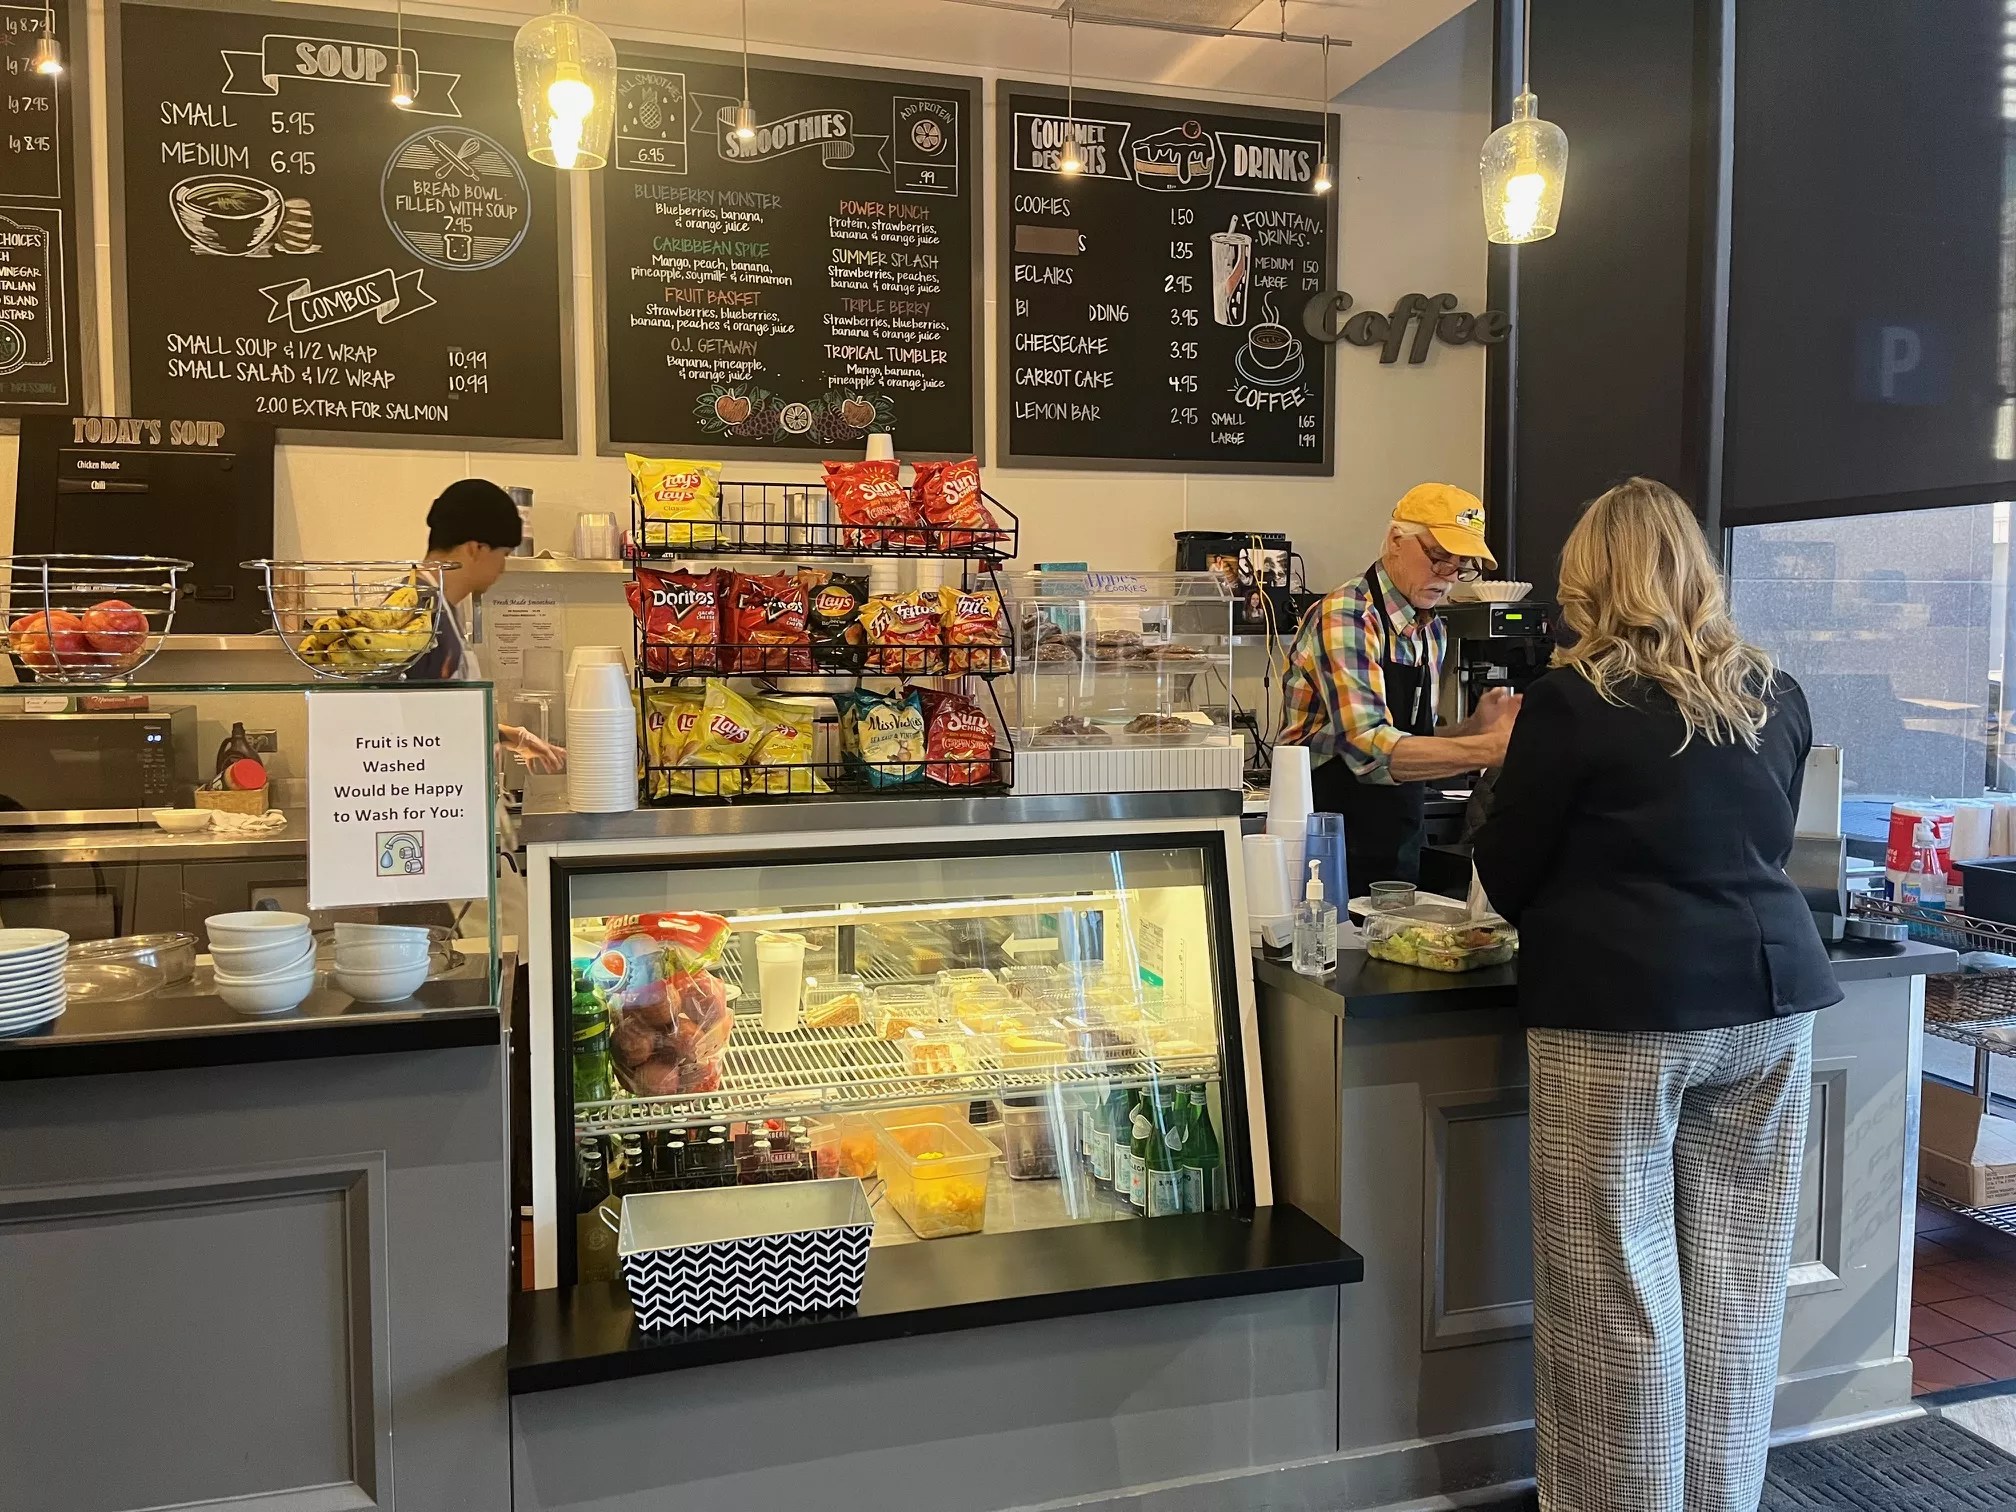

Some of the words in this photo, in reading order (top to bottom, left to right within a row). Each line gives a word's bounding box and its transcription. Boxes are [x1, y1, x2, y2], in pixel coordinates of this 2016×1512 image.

[296, 42, 387, 81] SOUP
[22, 97, 49, 111] 7.95
[900, 104, 918, 120] ADD
[918, 102, 954, 124] PROTEIN
[161, 101, 237, 127] SMALL
[271, 112, 315, 135] 5.95
[725, 113, 847, 158] SMOOTHIES
[162, 142, 249, 169] MEDIUM
[271, 151, 316, 174] 6.95
[638, 148, 665, 162] 6.95
[1234, 144, 1311, 182] DRINKS
[919, 170, 935, 184] .99
[414, 180, 459, 198] BREAD
[465, 184, 503, 200] BOWL
[635, 184, 714, 205] BLUEBERRY
[719, 191, 782, 210] MONSTER
[396, 195, 445, 213] FILLED
[450, 201, 483, 217] WITH
[486, 203, 517, 219] SOUP
[656, 203, 718, 220] Blueberries,
[721, 208, 763, 223] banana,
[840, 200, 886, 217] POWER
[889, 203, 930, 220] PUNCH
[1015, 195, 1070, 217] COOKIES
[1171, 208, 1194, 225] 1.50
[444, 216, 472, 232] 7.95
[686, 219, 722, 233] orange
[723, 220, 750, 234] juice
[829, 216, 870, 230] Protein,
[872, 219, 937, 234] strawberries,
[653, 236, 731, 255] CARIBBEAN
[735, 242, 770, 258] SPICE
[830, 228, 868, 240] banana
[881, 232, 916, 246] orange
[917, 234, 940, 247] juice
[652, 255, 691, 270] Mango,
[694, 258, 728, 271] peach,
[731, 259, 773, 273] banana,
[832, 248, 888, 266] SUMMER
[891, 252, 939, 269] SPLASH
[1255, 257, 1293, 271] MEDIUM
[631, 267, 684, 283] pineapple,
[686, 269, 727, 283] soymilk
[740, 273, 793, 286] cinnamon
[828, 265, 895, 281] Strawberries,
[897, 272, 940, 284] peaches,
[1015, 265, 1073, 285] ECLAIRS
[1164, 274, 1193, 293] 2.95
[1254, 275, 1288, 289] LARGE
[1302, 278, 1318, 291] 1.79
[830, 277, 869, 290] banana
[882, 282, 915, 296] orange
[917, 283, 941, 296] juice
[3, 296, 39, 306] ISLAND
[301, 281, 382, 323] COMBOS
[665, 287, 704, 304] FRUIT
[707, 290, 761, 306] BASKET
[646, 304, 718, 319] Strawberries,
[721, 308, 780, 322] blueberries,
[841, 298, 886, 314] TRIPLE
[890, 301, 930, 317] BERRY
[630, 314, 674, 330] banana,
[677, 319, 720, 332] peaches
[733, 321, 769, 336] orange
[770, 323, 795, 336] juice
[823, 314, 890, 328] Strawberries,
[892, 318, 950, 331] blueberries,
[1170, 309, 1198, 326] 3.95
[1303, 290, 1513, 364] Coffee
[832, 326, 869, 338] banana
[882, 330, 916, 343] orange
[916, 331, 941, 344] juice
[167, 334, 231, 355] SMALL
[236, 338, 277, 359] SOUP
[283, 341, 294, 359] &
[299, 341, 323, 360] 1/2
[328, 343, 378, 363] WRAP
[449, 351, 487, 369] 10.99
[671, 337, 693, 352] O.J.
[698, 338, 758, 356] GETAWAY
[824, 344, 883, 360] TROPICAL
[886, 347, 948, 364] TUMBLER
[1015, 333, 1108, 354] CHEESECAKE
[1170, 341, 1198, 359] 3.95
[666, 355, 712, 369] Banana,
[714, 359, 767, 373] pineapple,
[1880, 325, 1921, 397] P
[168, 359, 231, 379] SMALL
[237, 362, 295, 383] SALAD
[302, 367, 312, 384] &
[317, 367, 340, 385] 1/2
[345, 368, 395, 389] WRAP
[449, 375, 488, 393] 10.99
[689, 370, 725, 384] orange
[726, 371, 753, 384] juice
[846, 364, 882, 378] Mango,
[884, 365, 924, 378] banana,
[1016, 368, 1071, 387] CARROT
[1075, 370, 1114, 388] CAKE
[1169, 375, 1198, 392] 4.95
[828, 375, 875, 390] pineapple
[886, 378, 921, 391] orange
[920, 378, 946, 392] juice
[1235, 385, 1305, 412] COFFEE
[256, 397, 287, 413] 2.00
[292, 398, 348, 418] EXTRA
[352, 401, 381, 419] FOR
[386, 402, 448, 422] SALMON
[1016, 401, 1067, 420] LEMON
[1071, 404, 1100, 421] BAR
[1170, 407, 1198, 424] 2.95
[1211, 412, 1246, 425] SMALL
[1299, 415, 1315, 428] 1.65
[73, 417, 161, 445] TODAY'S
[170, 420, 225, 446] SOUP
[1211, 432, 1245, 445] LARGE
[1299, 434, 1315, 447] 1.99
[77, 460, 99, 469] Chicken
[101, 461, 120, 470] Noodle
[91, 480, 106, 490] Chili
[859, 480, 901, 500] Sun
[943, 475, 978, 504] Sun
[1105, 584, 1147, 592] COOKIES
[653, 590, 714, 606] Doritos
[868, 716, 894, 730] Miss
[948, 712, 989, 731] Sun
[356, 737, 392, 749] Fruit
[397, 737, 408, 748] is
[413, 736, 441, 748] Not
[363, 760, 425, 773] Washed
[334, 784, 386, 798] Would
[391, 784, 409, 796] be
[415, 784, 463, 797] Happy
[334, 811, 350, 823] to
[355, 808, 398, 822] Wash
[404, 807, 425, 820] for
[430, 806, 465, 818] You:
